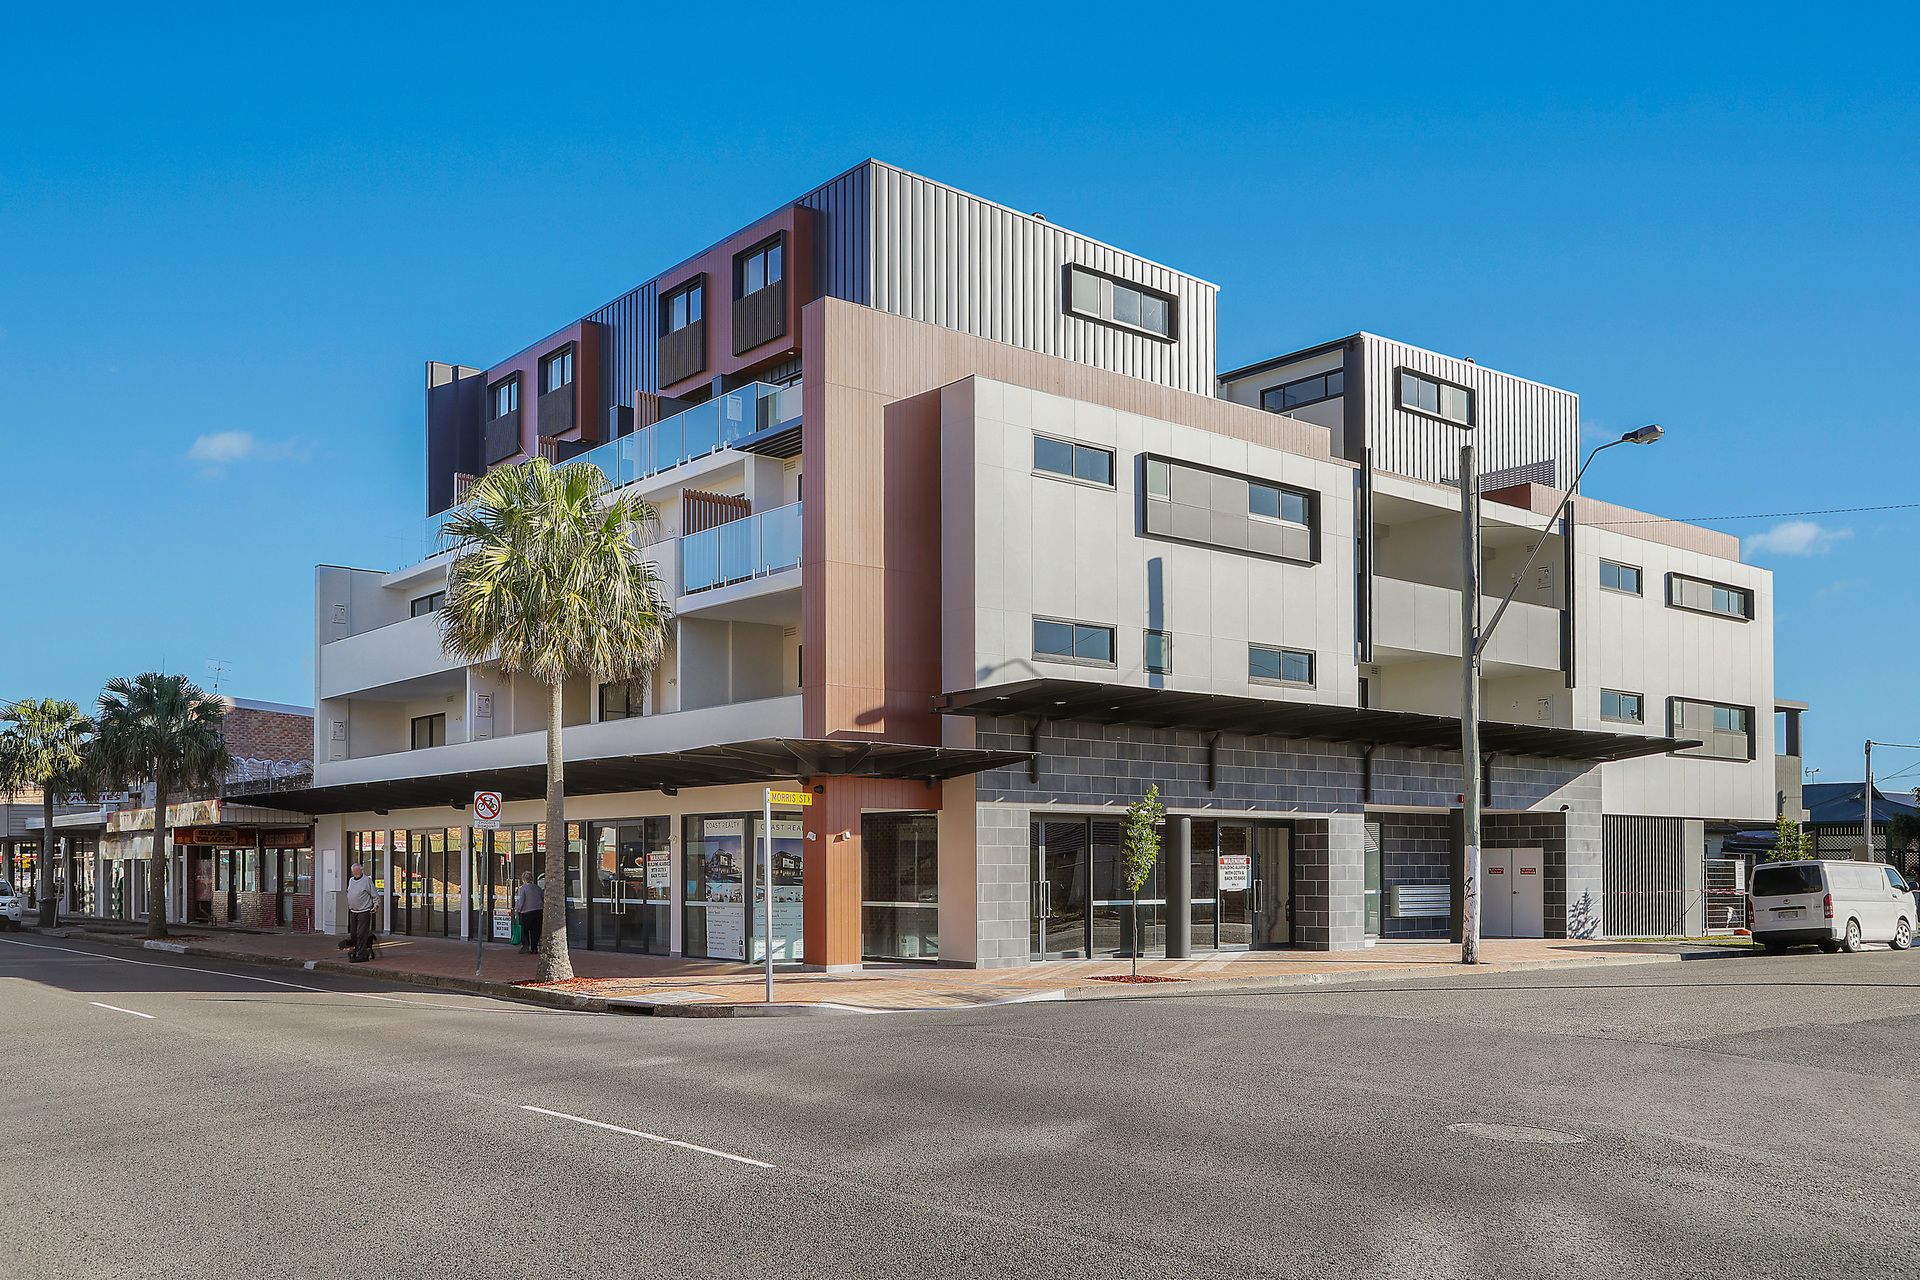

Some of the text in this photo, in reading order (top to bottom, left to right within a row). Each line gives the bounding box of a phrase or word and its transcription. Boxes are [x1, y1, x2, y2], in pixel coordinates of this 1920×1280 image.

[771, 792, 806, 803] MORRIS ST
[705, 821, 721, 829] COAST
[760, 823, 784, 831] CAST
